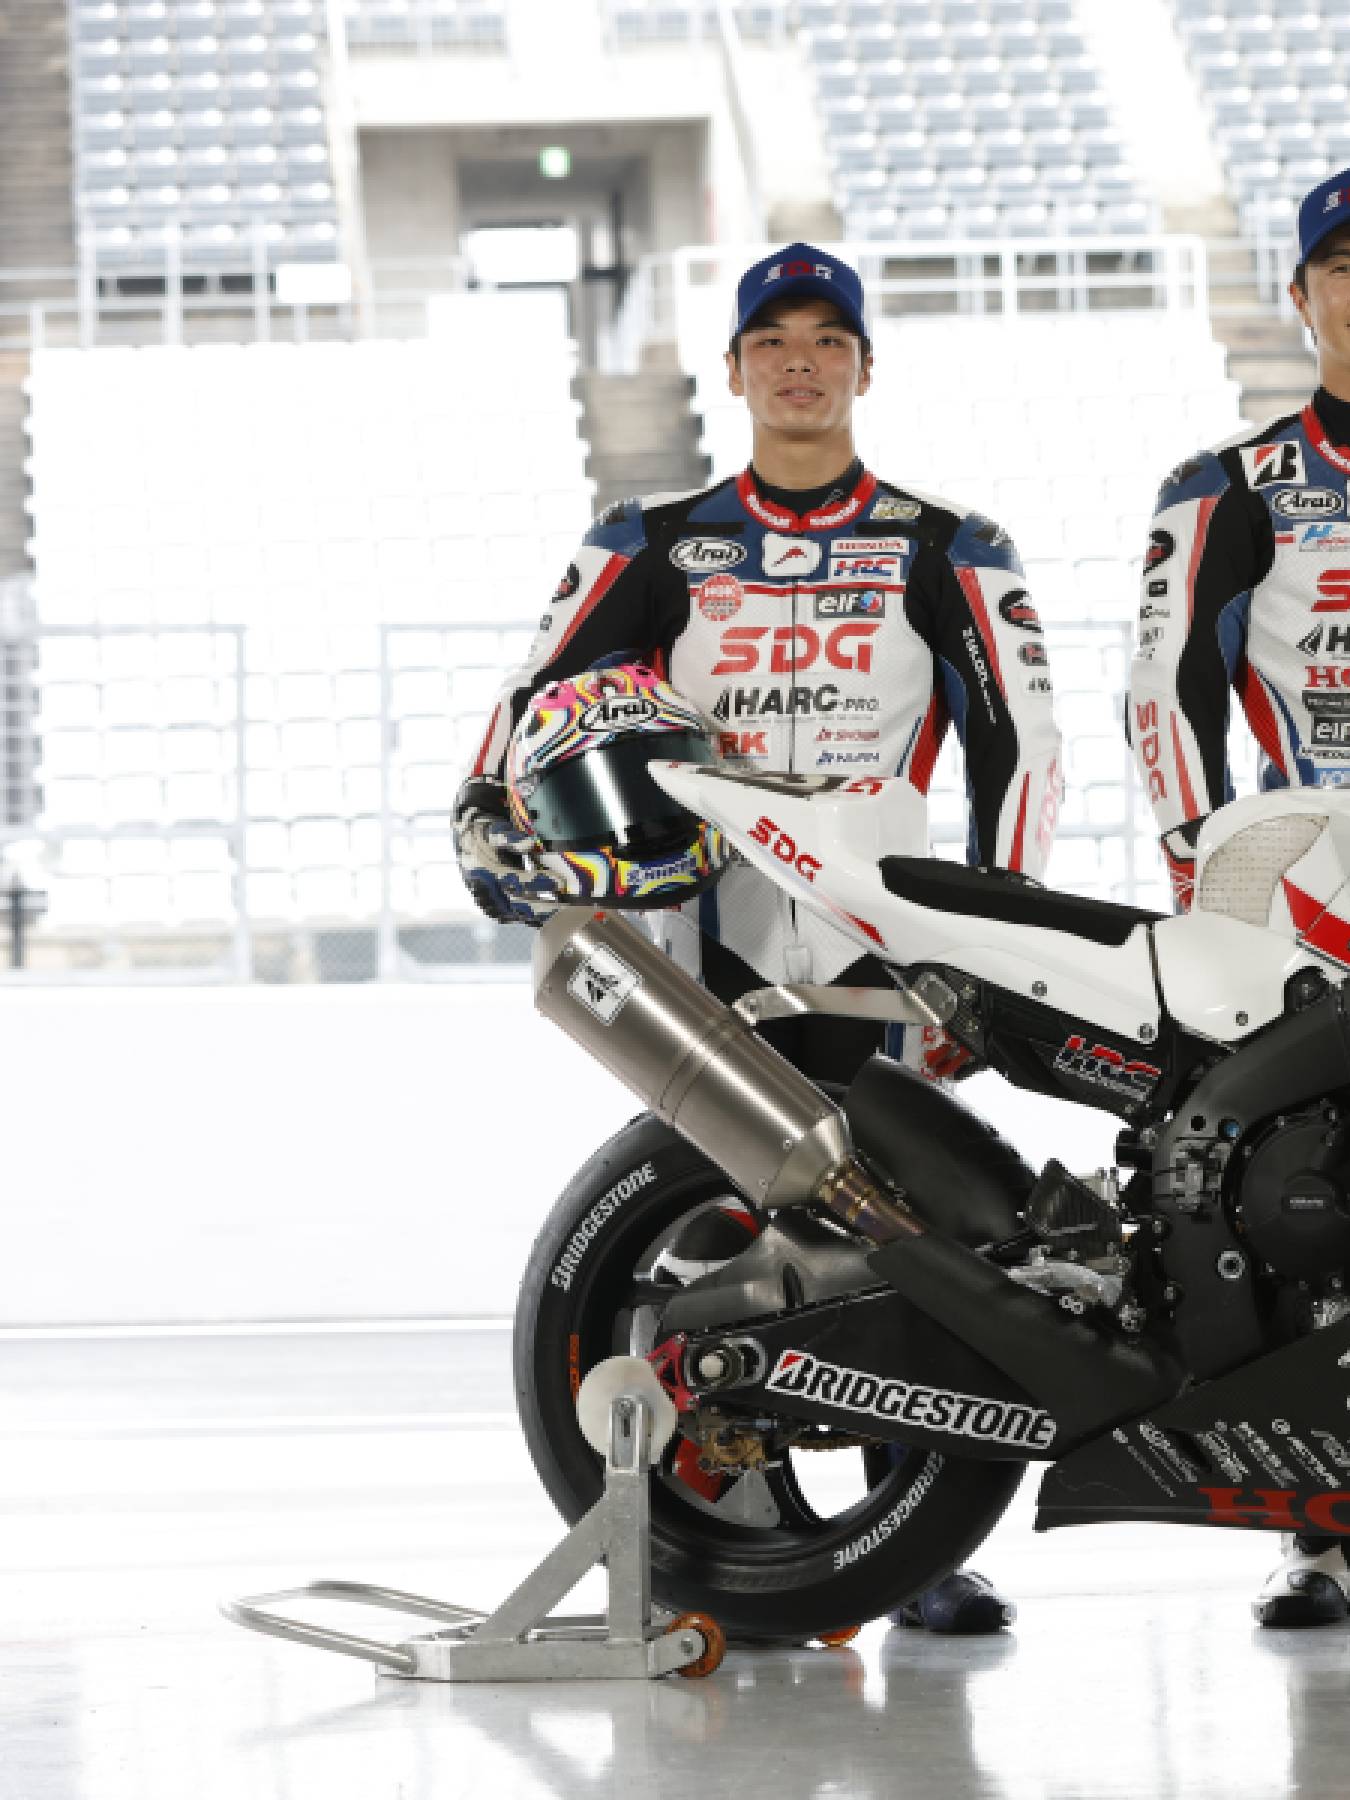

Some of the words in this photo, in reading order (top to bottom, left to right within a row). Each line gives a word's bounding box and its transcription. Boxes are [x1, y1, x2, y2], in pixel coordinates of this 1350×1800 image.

[1276, 489, 1340, 516] Arai
[673, 539, 744, 569] Arai
[836, 540, 904, 551] HONDA
[834, 558, 897, 577] HRC
[818, 594, 859, 613] elf
[710, 622, 881, 676] SDG
[584, 698, 653, 730] Arai
[719, 731, 768, 755] RK
[1135, 699, 1168, 803] SDG
[747, 815, 823, 883] SDG
[551, 1162, 657, 1290] BRIDGESTONE
[765, 1349, 1057, 1450] BRIDGESTONE
[834, 1450, 944, 1571] BRIDGESTONE
